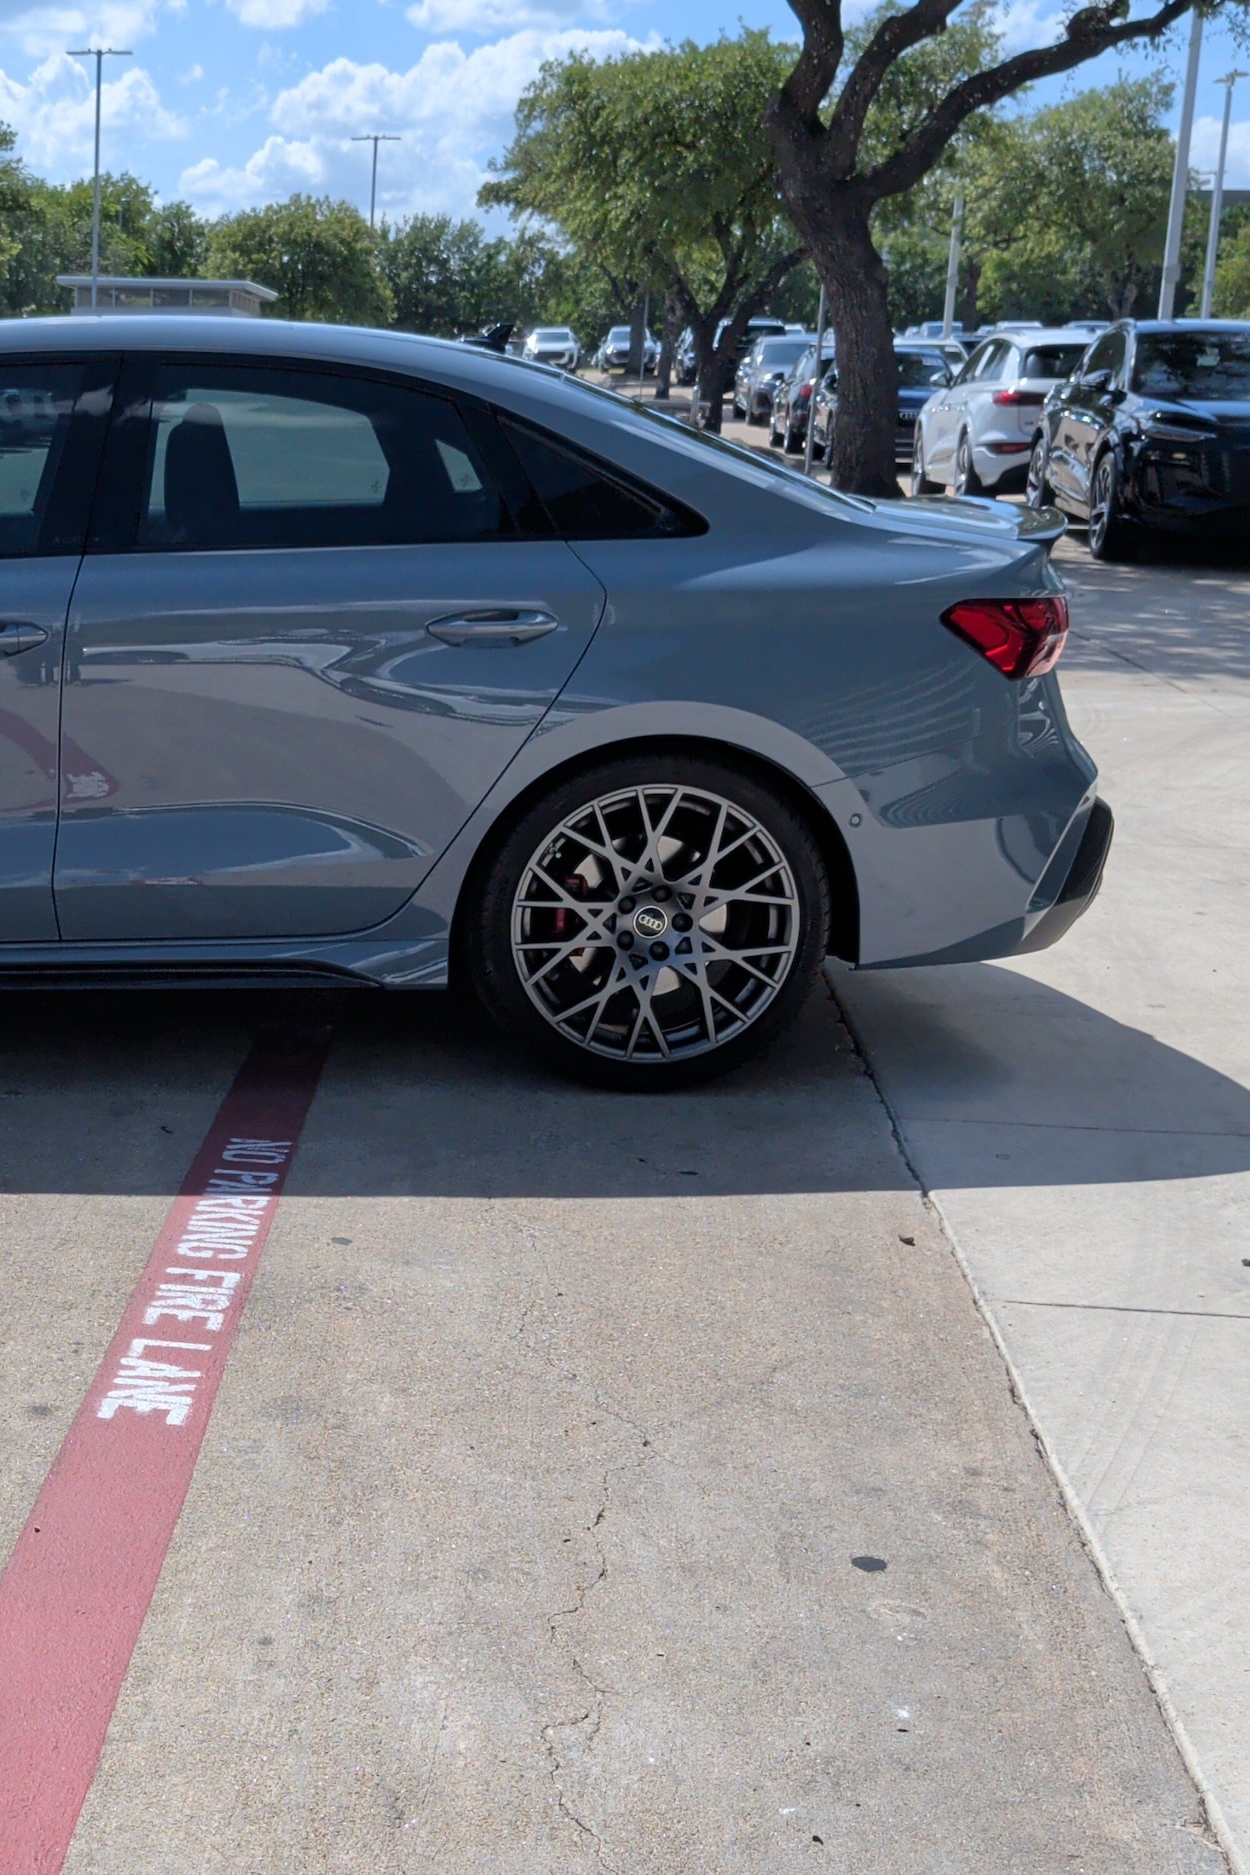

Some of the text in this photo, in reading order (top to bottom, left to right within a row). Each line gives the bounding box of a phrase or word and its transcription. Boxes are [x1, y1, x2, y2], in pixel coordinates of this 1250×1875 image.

[96, 1137, 292, 1427] NO PARKING FIRE LANE
